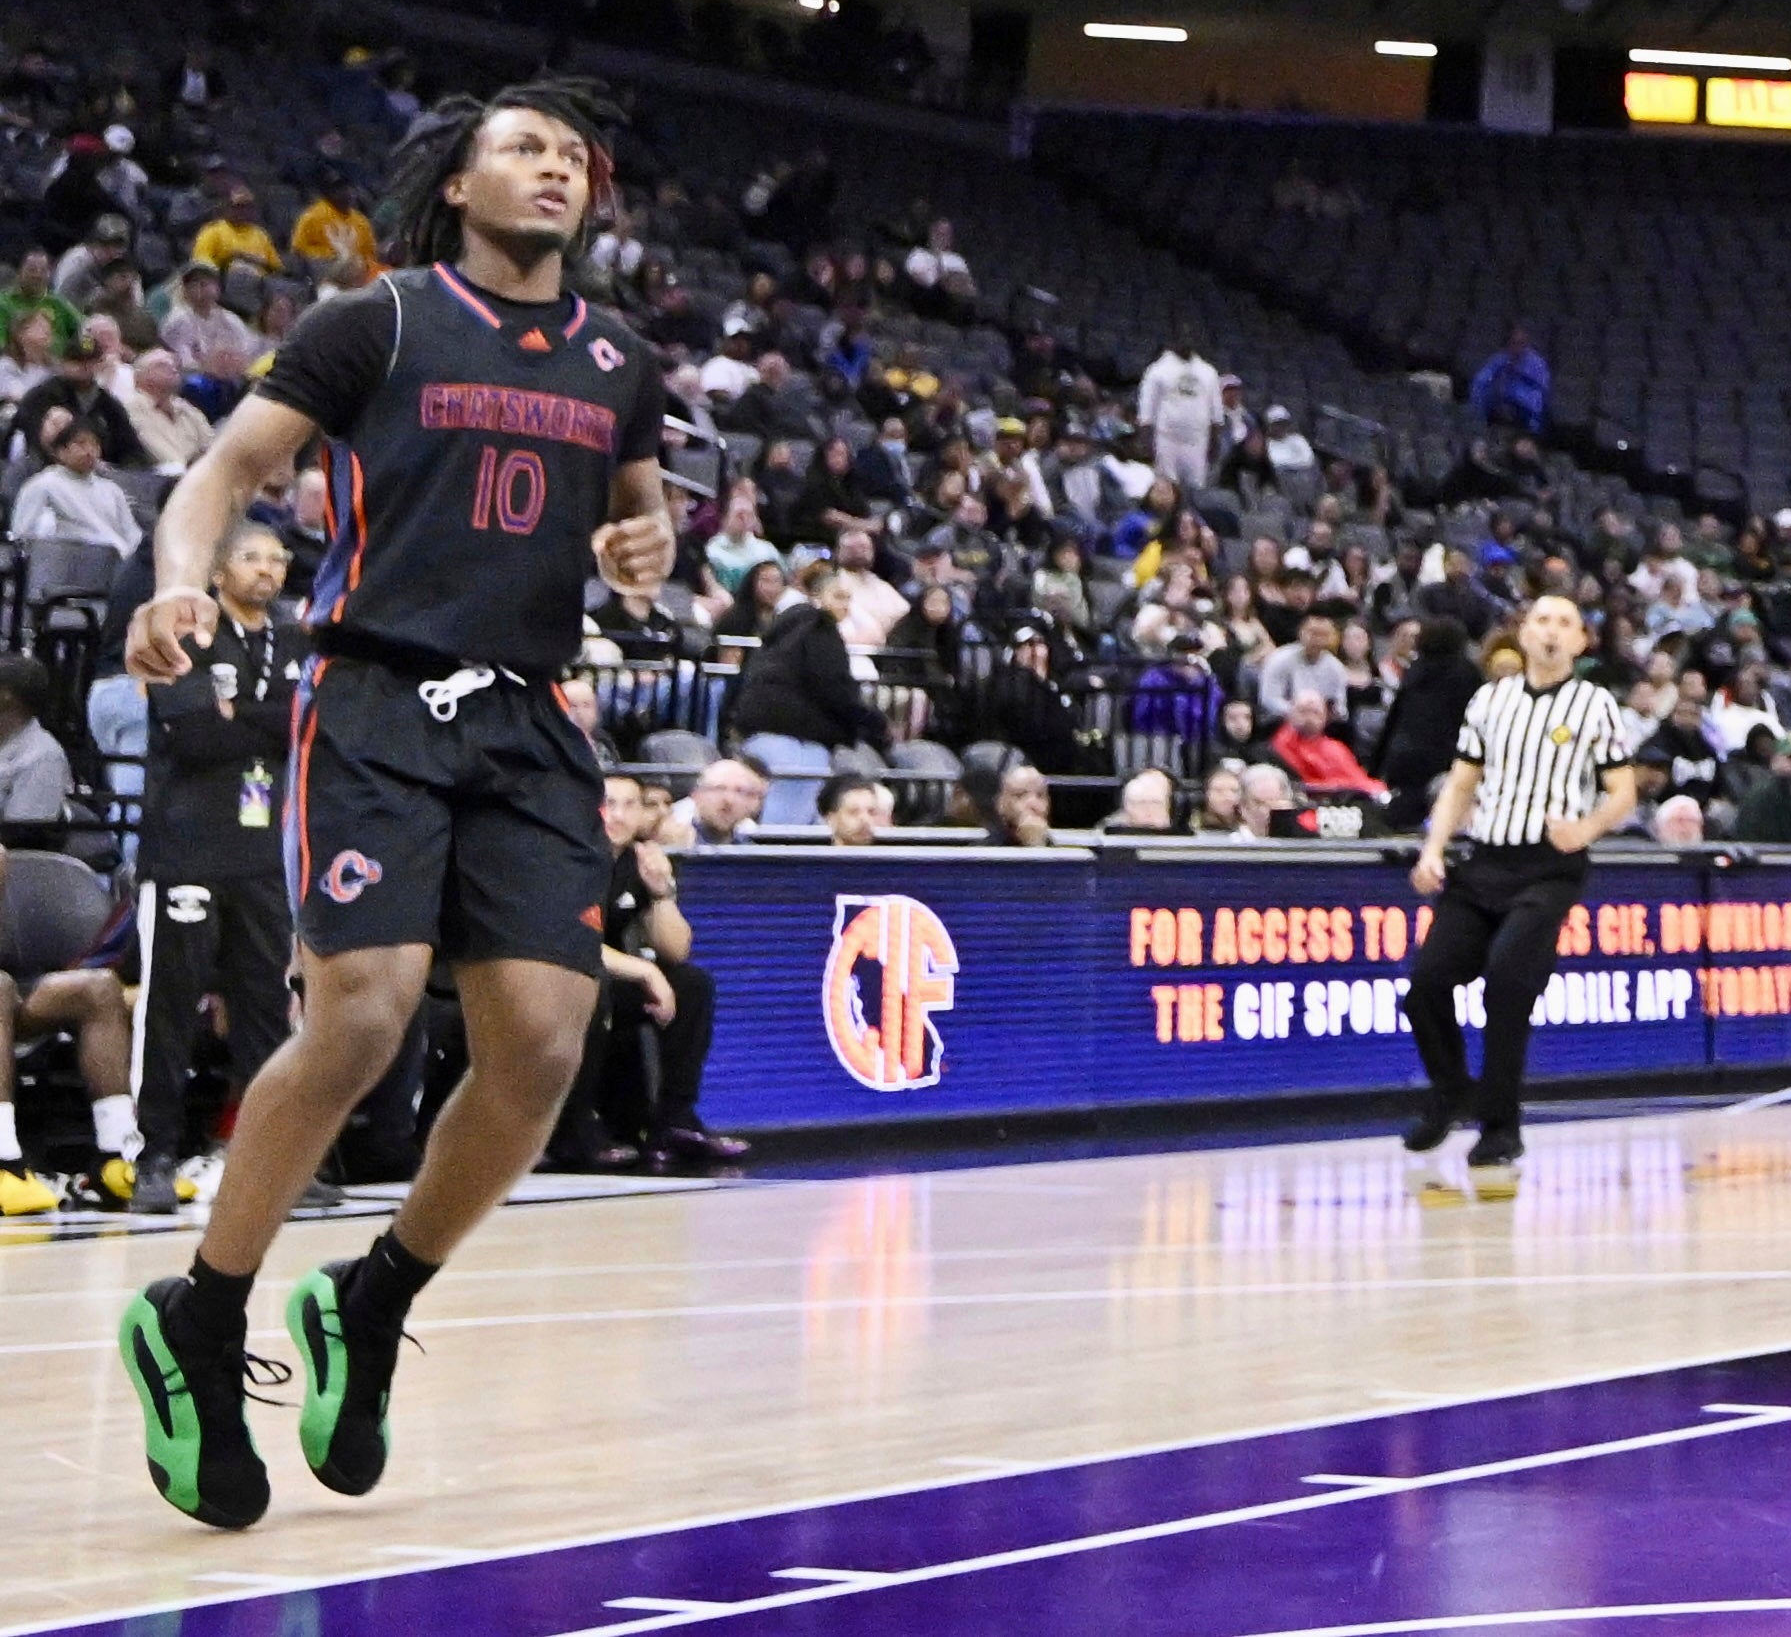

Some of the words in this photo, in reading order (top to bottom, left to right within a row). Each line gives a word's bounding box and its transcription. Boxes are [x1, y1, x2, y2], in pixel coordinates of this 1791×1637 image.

[471, 445, 548, 536] 10
[1130, 907, 1203, 966] FOR
[1212, 907, 1353, 964] ACCESS
[1360, 905, 1407, 961] TO
[1151, 983, 1224, 1043] THE
[1234, 981, 1295, 1040] CIF
[1303, 978, 1412, 1037] SPORT
[1635, 968, 1692, 1021] APP
